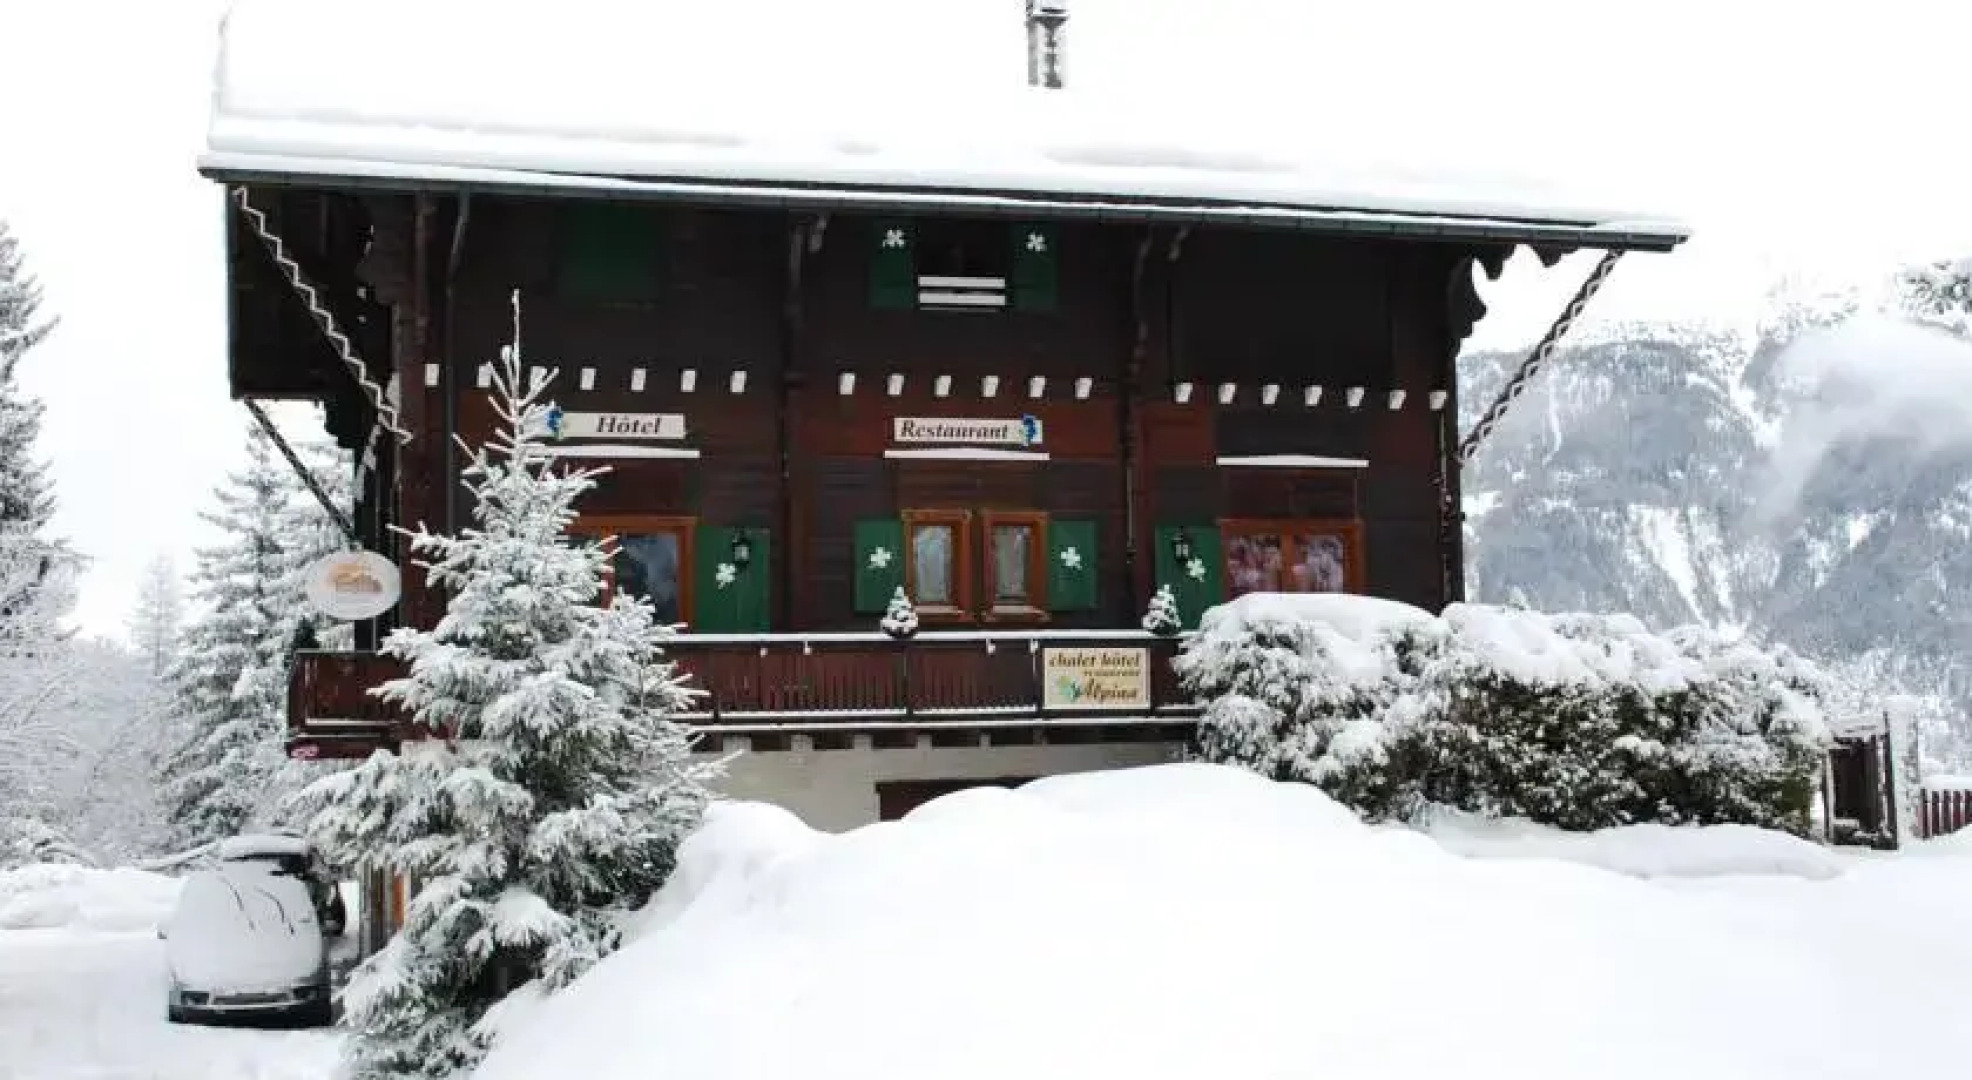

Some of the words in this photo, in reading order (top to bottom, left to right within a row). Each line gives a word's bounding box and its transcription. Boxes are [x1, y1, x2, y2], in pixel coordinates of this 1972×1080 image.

[596, 416, 661, 433] Hôtel
[901, 419, 1008, 438] Restaurant
[1048, 652, 1096, 667] chalet
